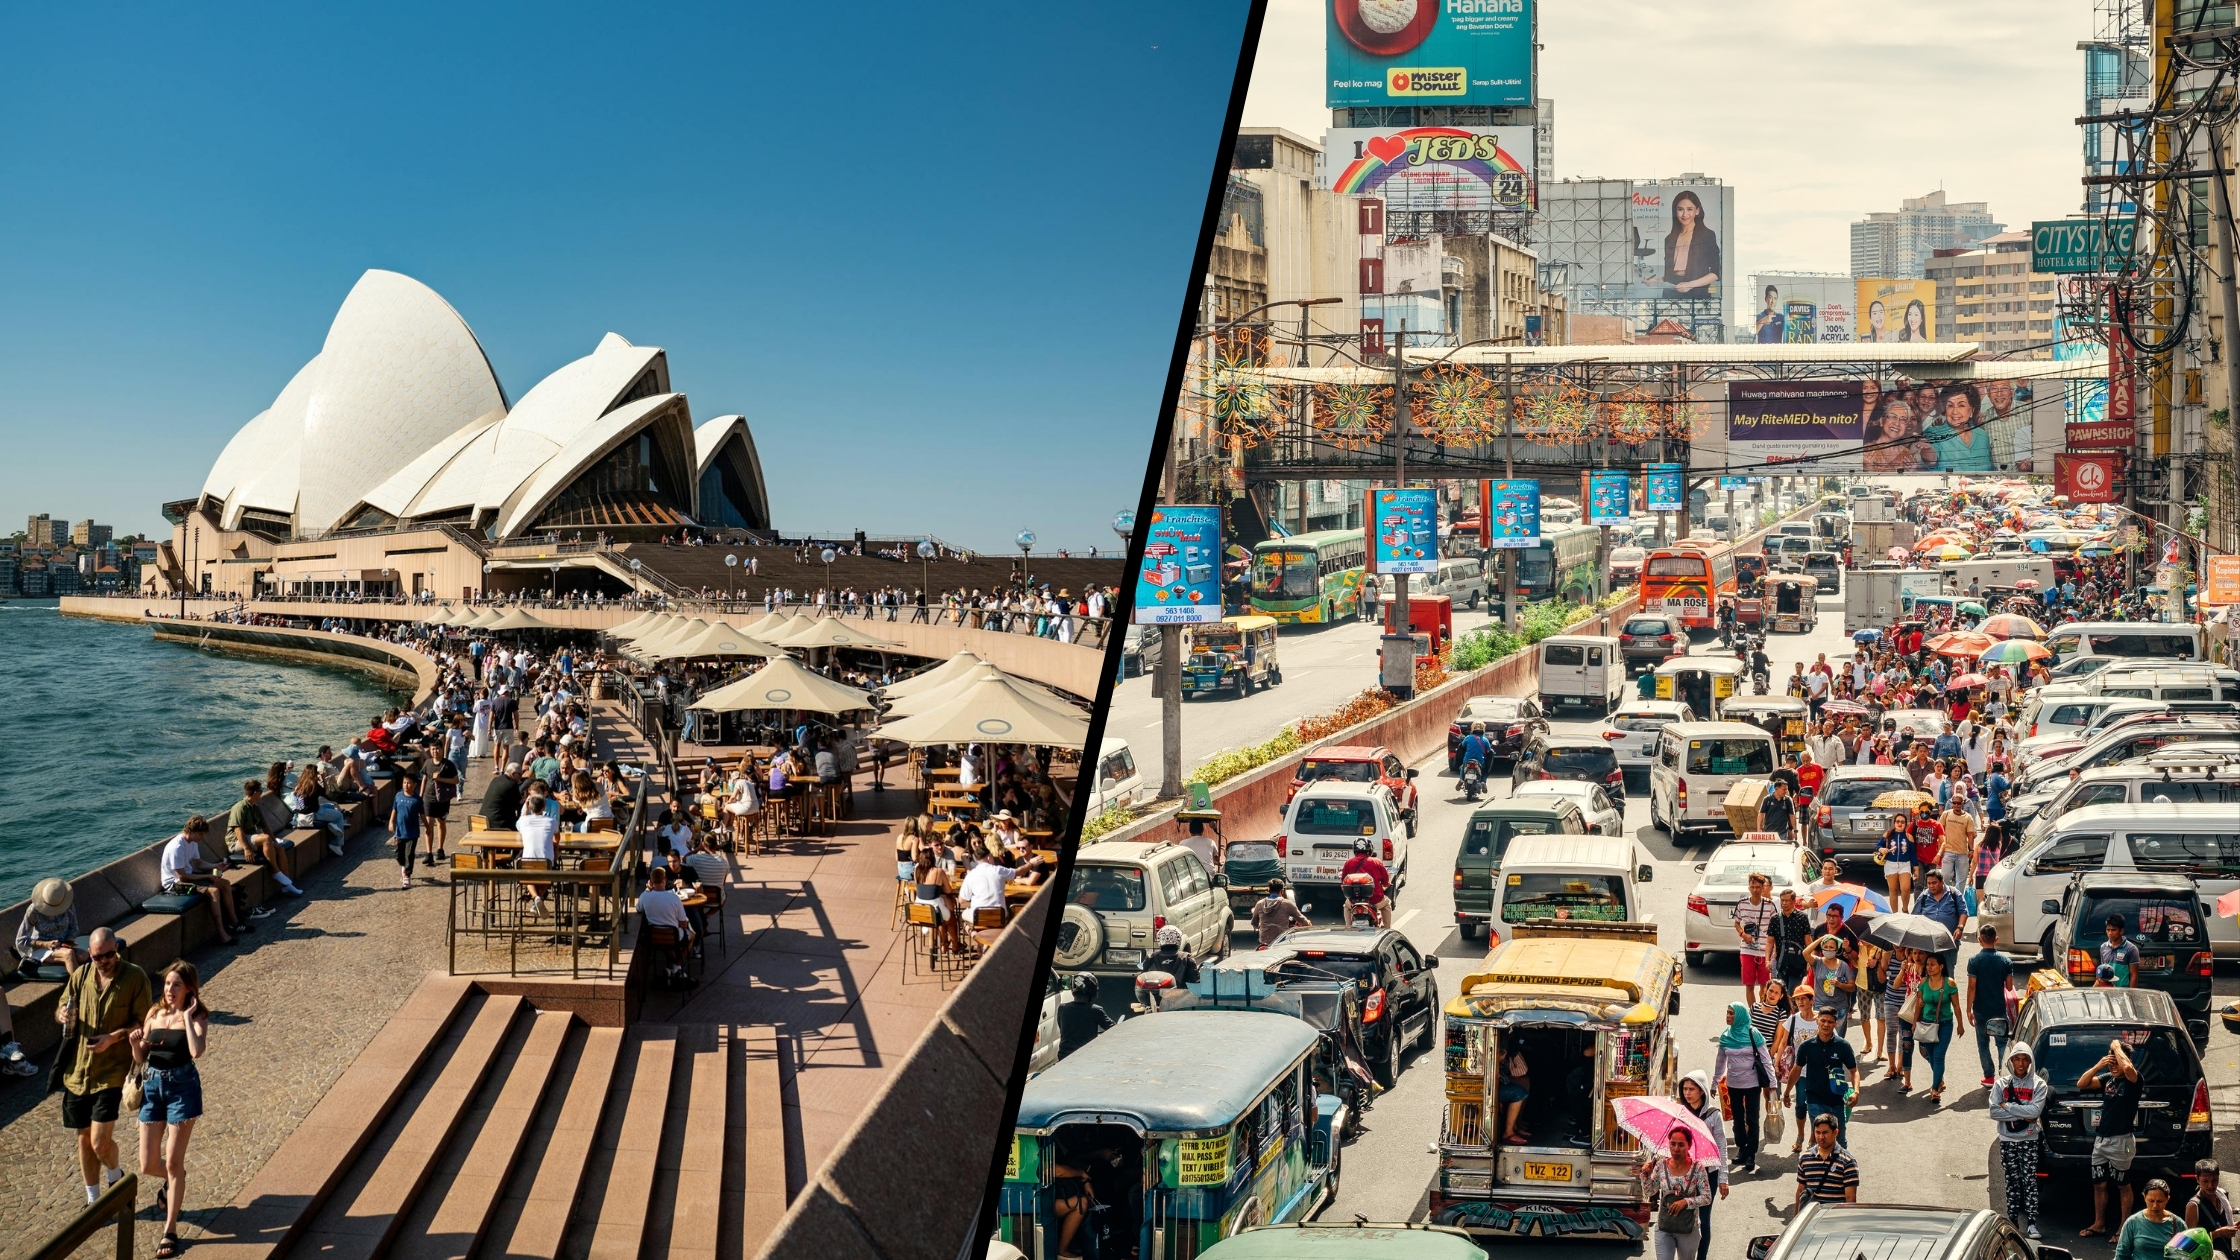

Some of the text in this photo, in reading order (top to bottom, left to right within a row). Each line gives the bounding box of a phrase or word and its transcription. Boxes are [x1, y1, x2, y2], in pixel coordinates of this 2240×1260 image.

[1412, 72, 1462, 82] mister
[1334, 80, 1383, 88] Feel ko mag
[1411, 82, 1462, 92] Donut
[1354, 134, 1498, 166] I JED'S
[1500, 173, 1522, 181] OPEN
[1499, 181, 1523, 196] 24
[2037, 257, 2066, 268] HOTEL
[2067, 257, 2074, 266] &
[1790, 319, 1811, 330] SUN
[1788, 332, 1814, 344] RAIN
[1741, 390, 1767, 399] Huwag
[1734, 413, 1858, 428] May RiteMED ba nito?
[2068, 427, 2134, 441] PAWNSHOP
[1166, 515, 1210, 524] Franchise
[1684, 598, 1706, 607] ROSE
[1496, 975, 1604, 986] SAN ANTONIO SPURS
[1202, 1141, 1214, 1150] 24/7
[1182, 1164, 1197, 1172] TEXT
[1530, 1165, 1568, 1176] TWZ 122
[1449, 1202, 1645, 1240] ARTHUR
